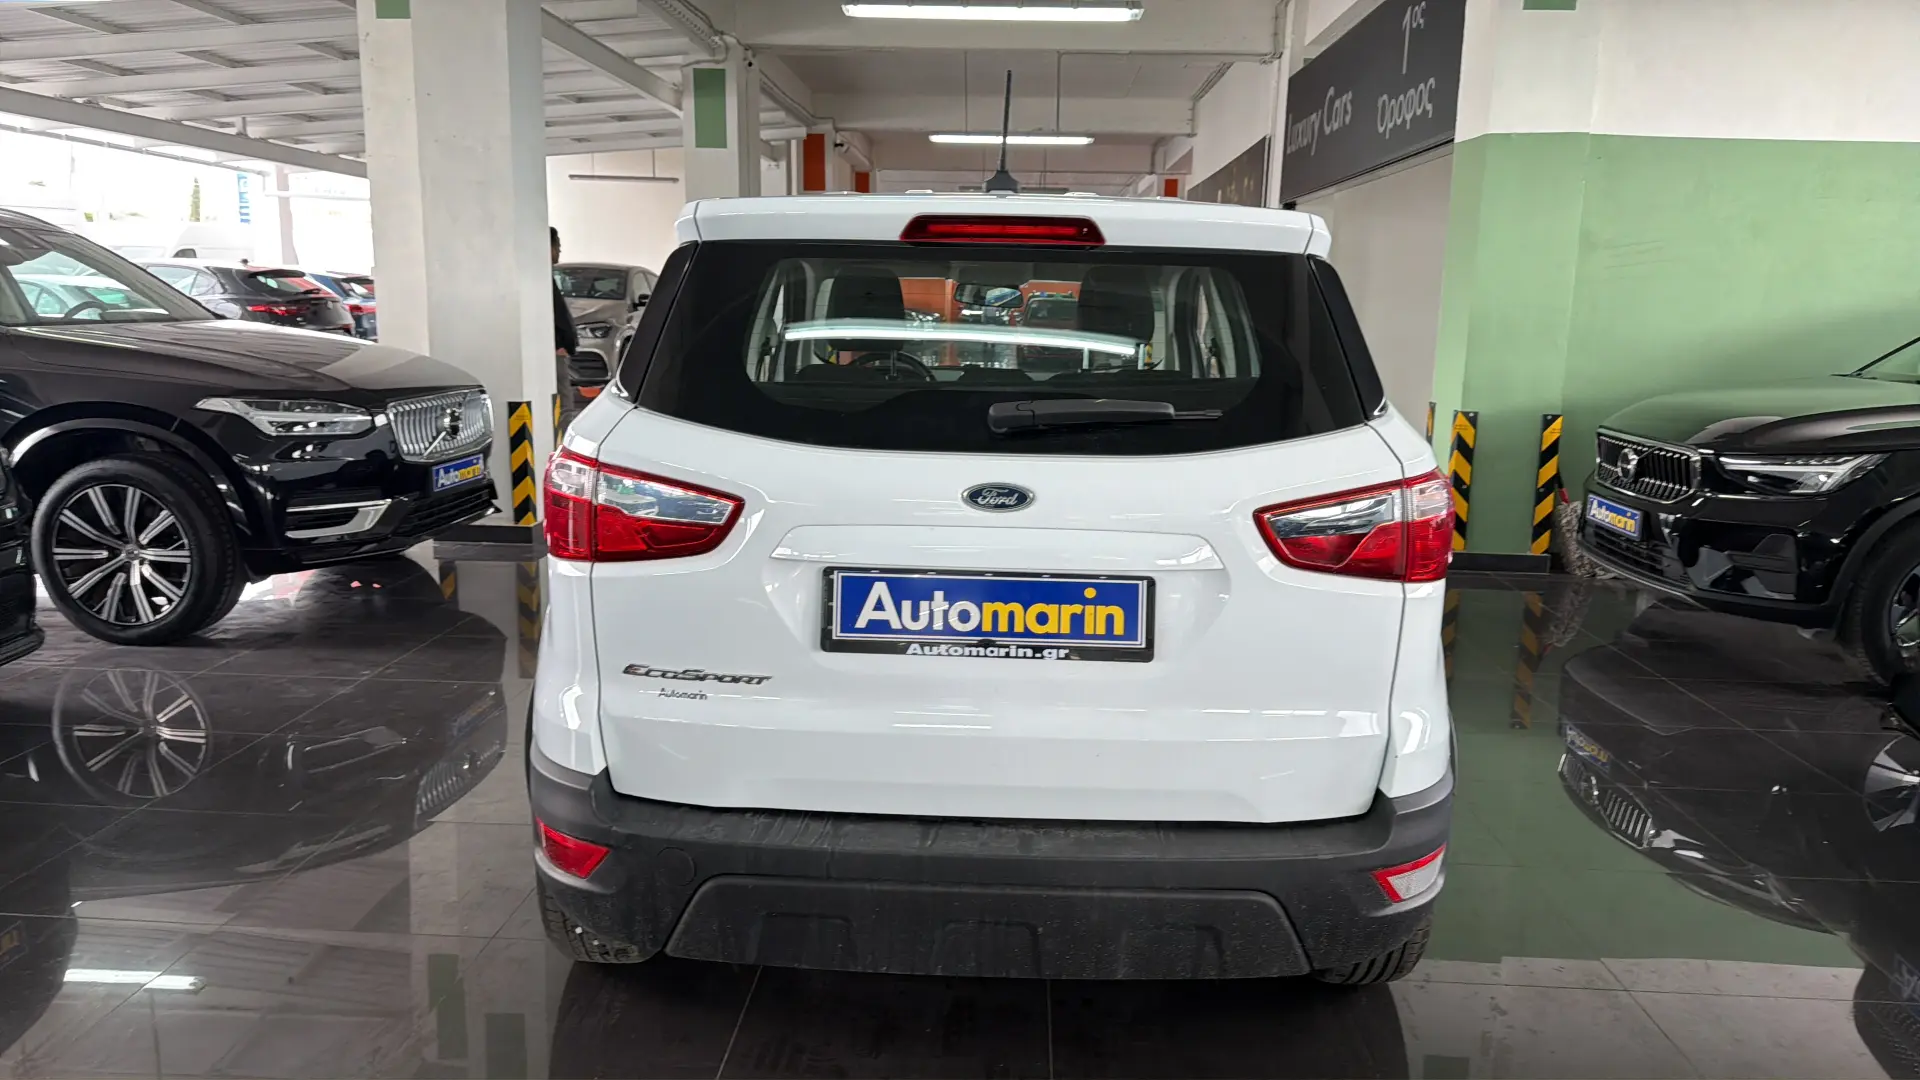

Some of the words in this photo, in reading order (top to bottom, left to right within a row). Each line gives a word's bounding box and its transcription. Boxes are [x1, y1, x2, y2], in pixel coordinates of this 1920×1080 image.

[1286, 109, 1323, 156] Luxury
[1323, 86, 1352, 135] Cars
[972, 487, 1019, 505] Ford
[854, 581, 1125, 636] Automarin
[905, 642, 1070, 660] Automarin.gr
